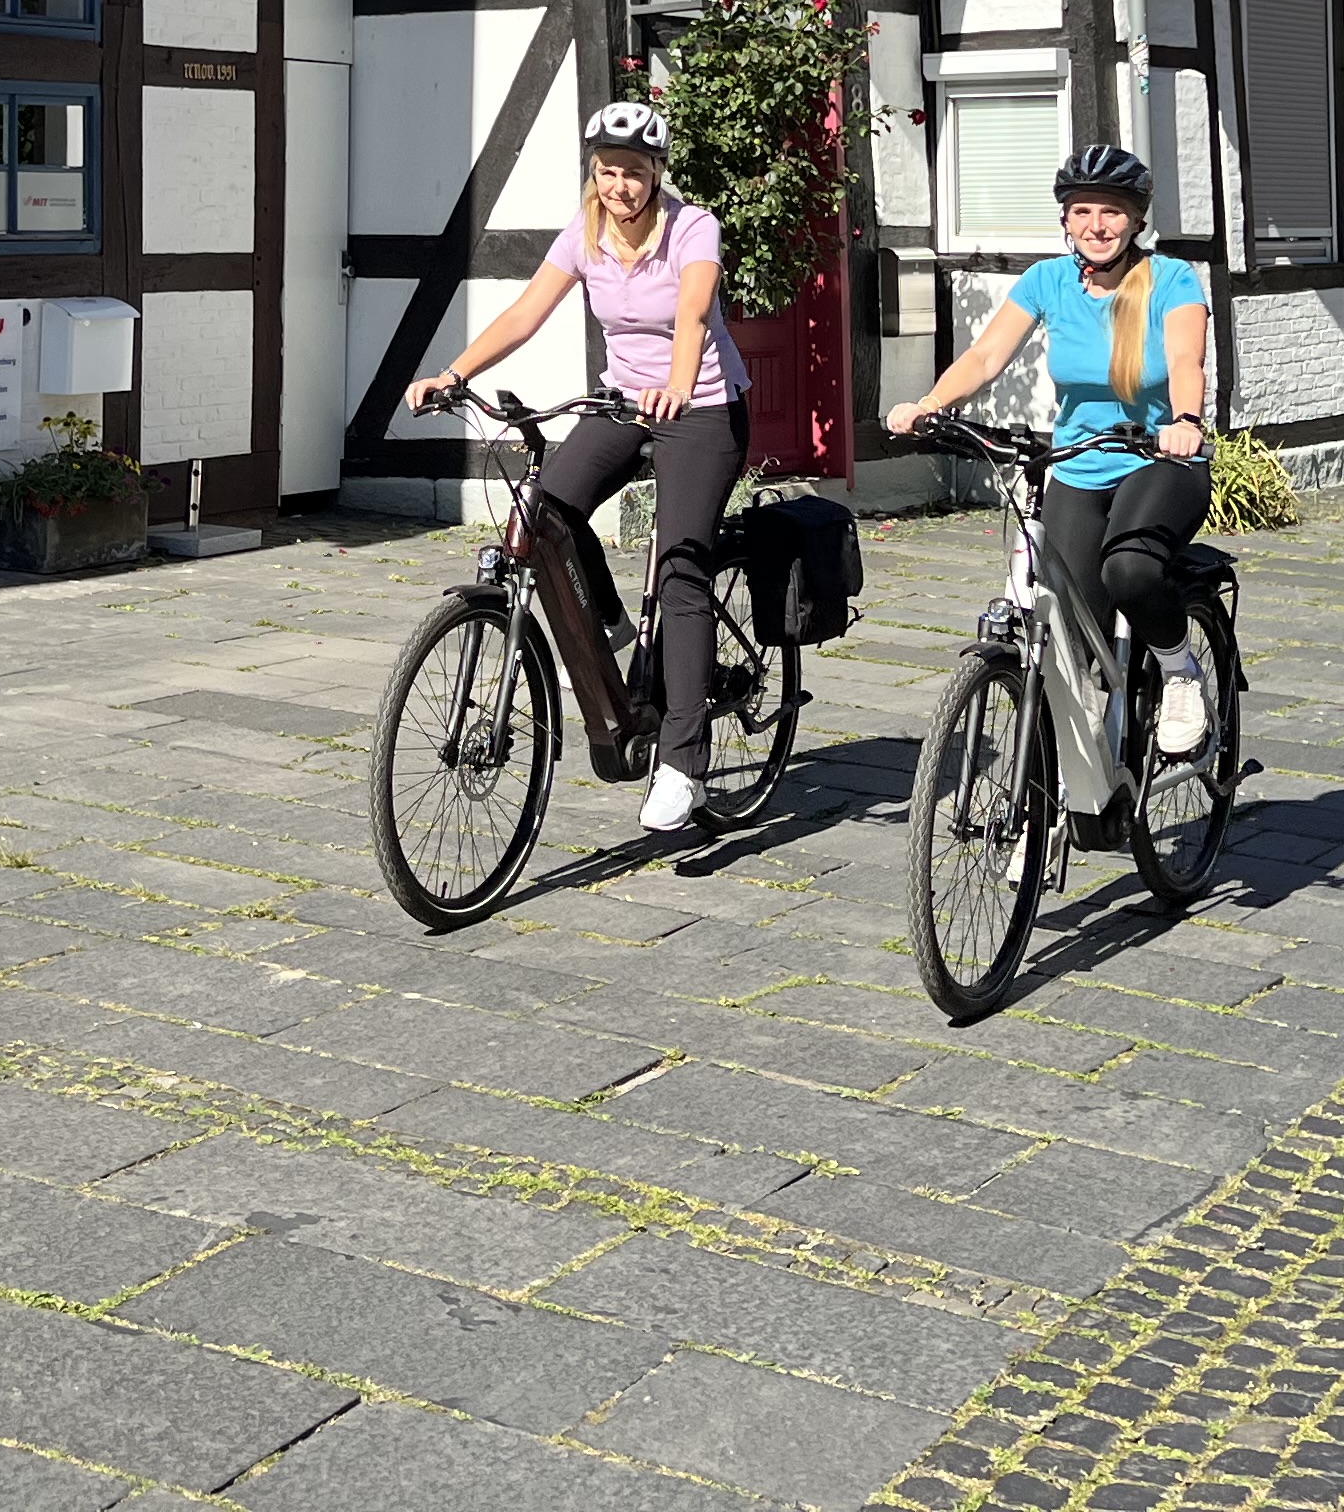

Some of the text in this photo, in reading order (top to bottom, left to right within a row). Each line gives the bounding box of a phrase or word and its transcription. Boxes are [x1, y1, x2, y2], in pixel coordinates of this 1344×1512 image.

[216, 64, 236, 81] 1991
[851, 83, 864, 113] 8
[32, 197, 48, 207] MIT
[565, 558, 588, 609] VICTORIA
